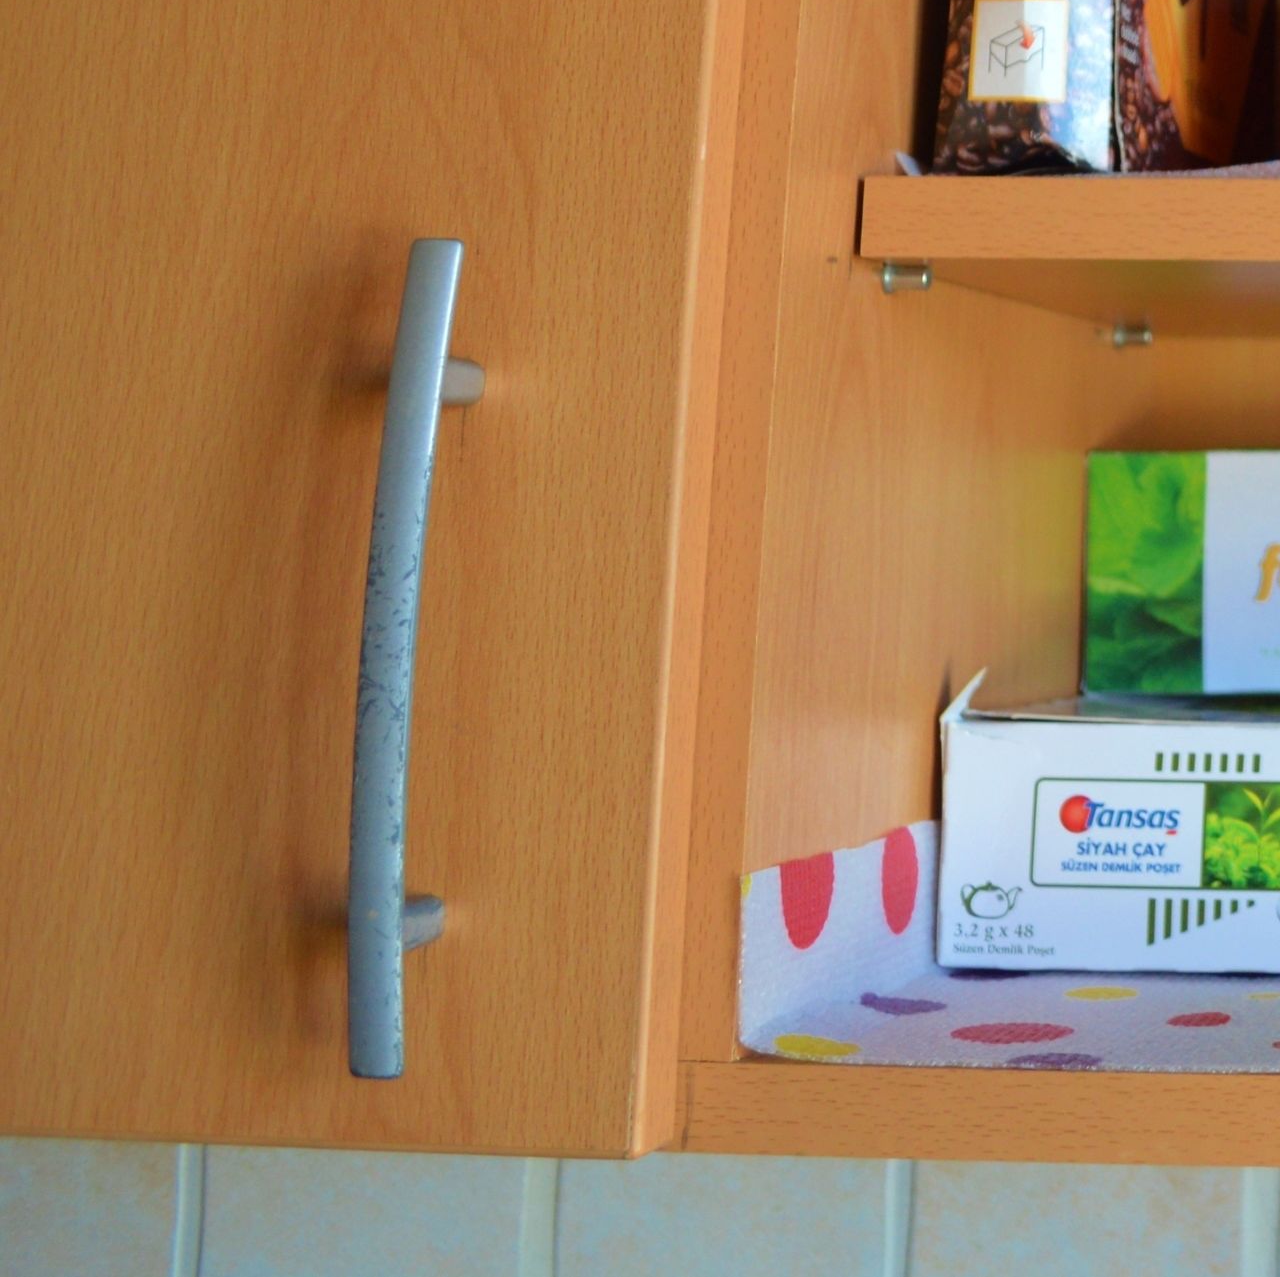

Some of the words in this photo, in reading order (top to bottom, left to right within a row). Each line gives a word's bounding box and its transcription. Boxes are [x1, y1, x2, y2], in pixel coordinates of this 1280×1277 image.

[1084, 800, 1181, 836] Tansaş
[1076, 837, 1128, 857] SİYAH
[1132, 841, 1167, 860] ÇAY
[1060, 858, 1099, 873] SÜZEN
[984, 925, 994, 942] g
[999, 926, 1009, 938] x
[1013, 923, 1035, 939] 48
